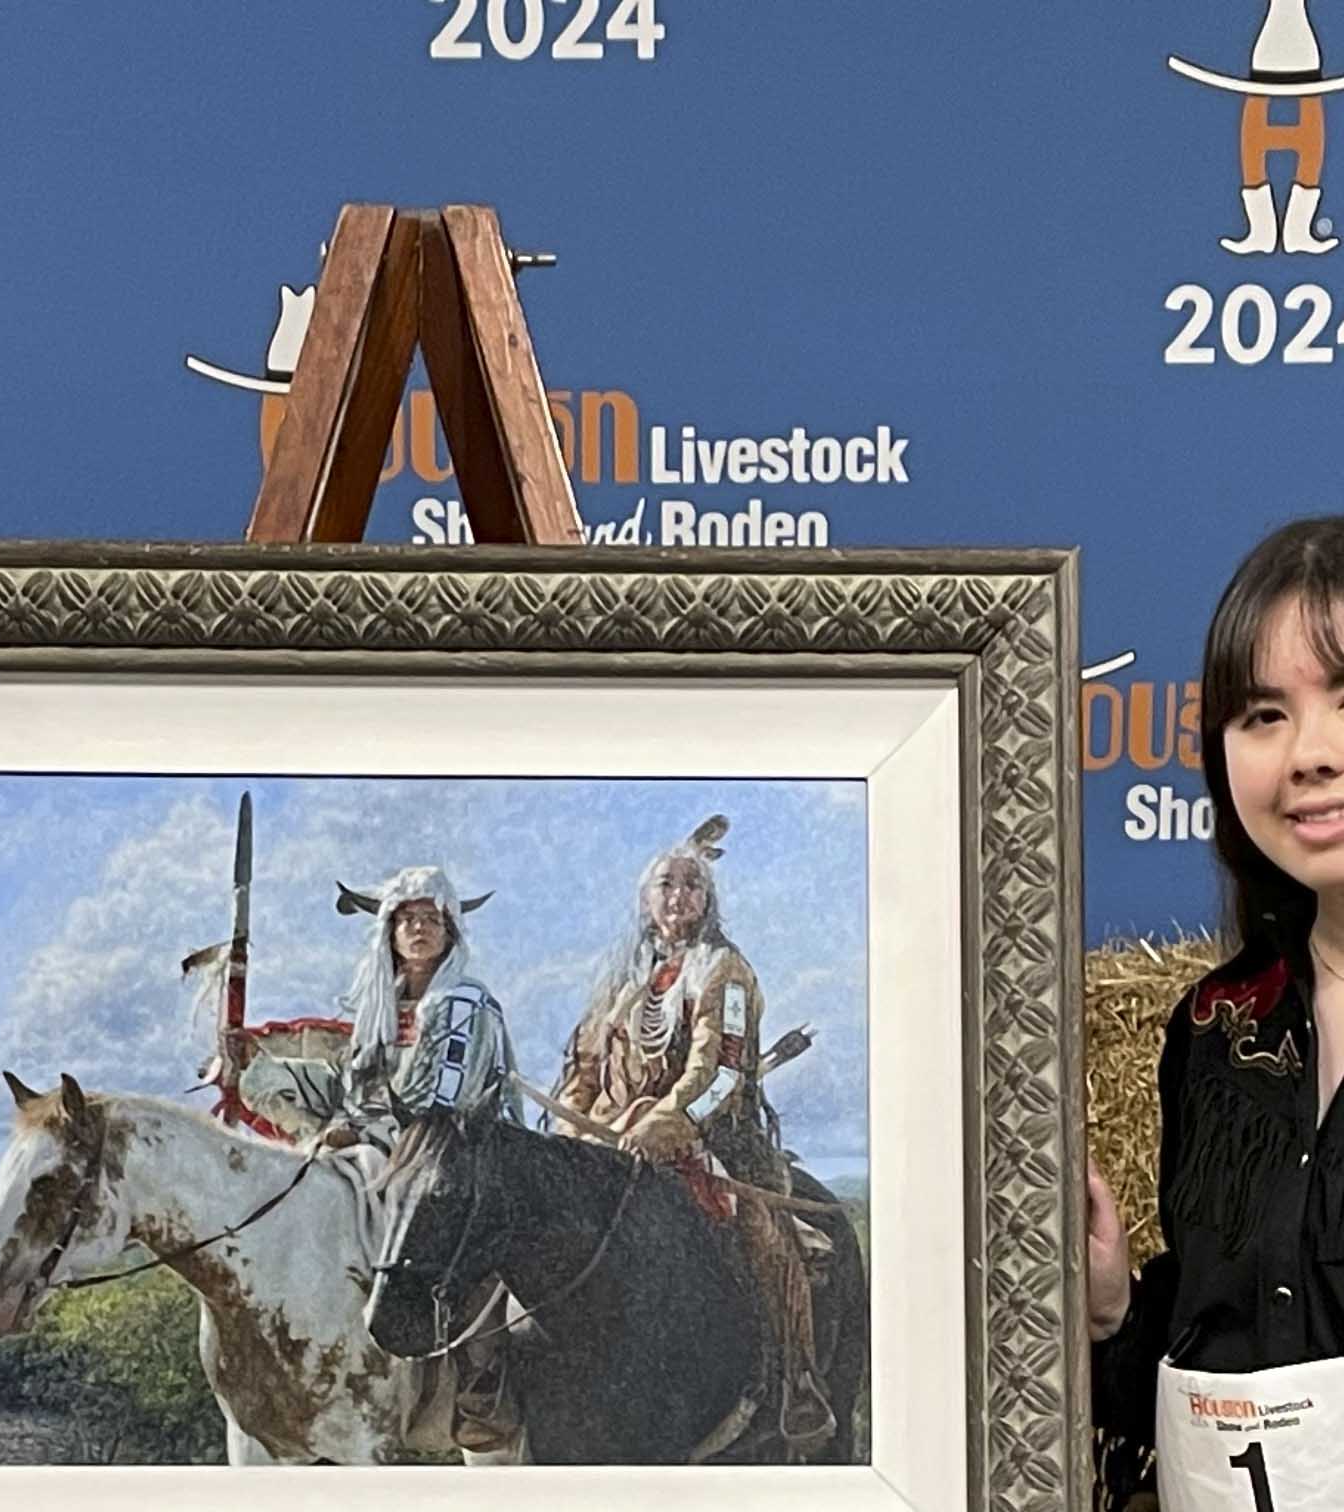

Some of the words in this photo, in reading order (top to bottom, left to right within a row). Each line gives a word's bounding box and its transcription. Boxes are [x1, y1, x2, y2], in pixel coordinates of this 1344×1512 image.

[430, 0, 665, 60] 2024
[650, 425, 909, 484] Livestock
[412, 498, 476, 545] Sh
[661, 500, 829, 546] Rodeo
[1124, 783, 1218, 841] Sho
